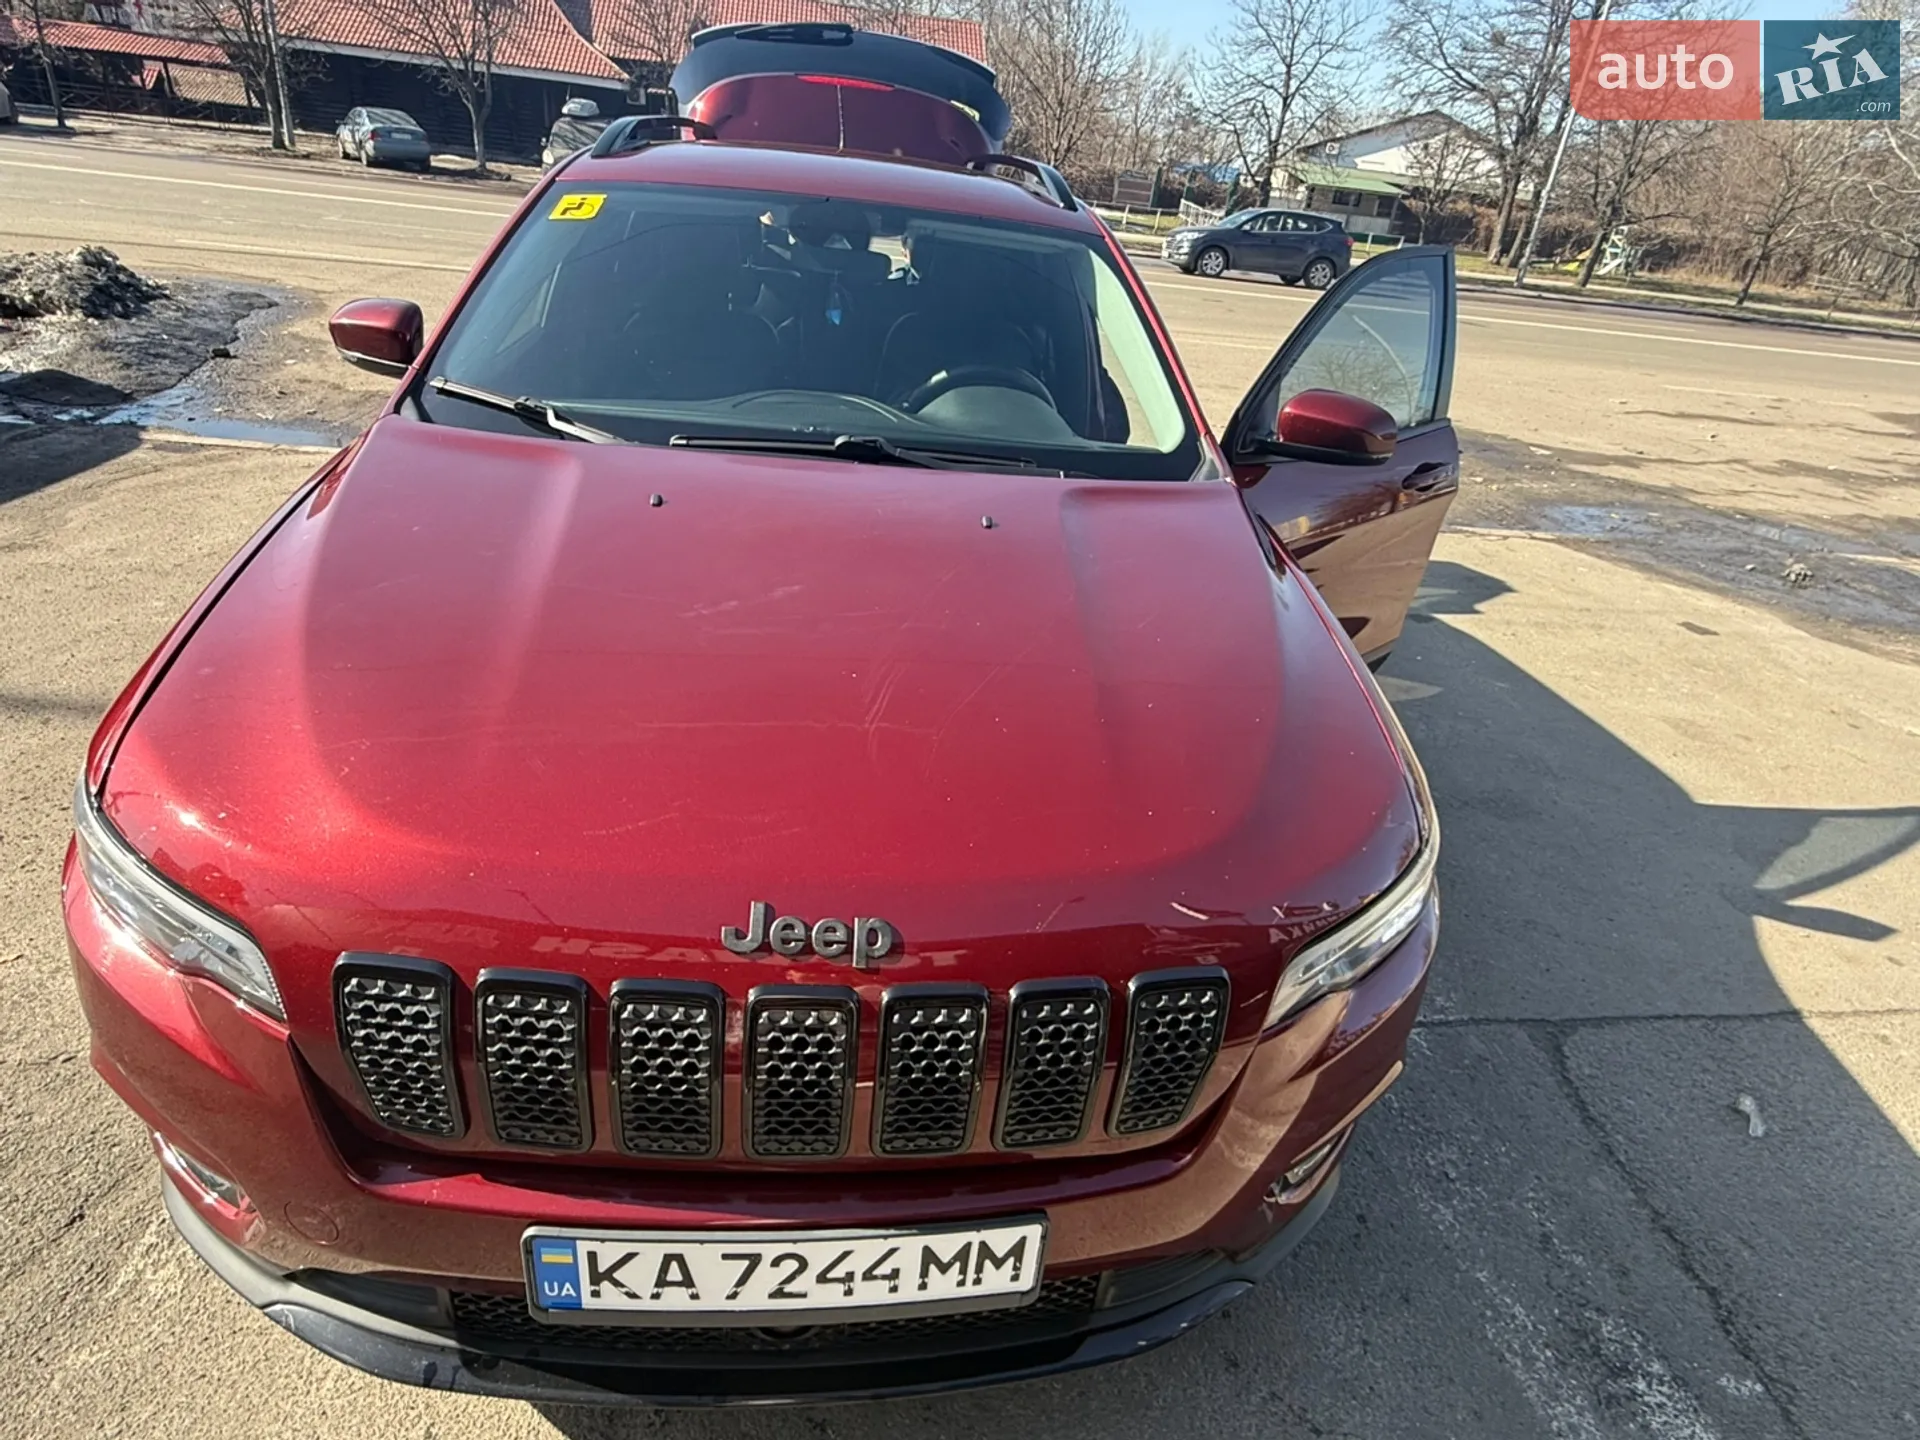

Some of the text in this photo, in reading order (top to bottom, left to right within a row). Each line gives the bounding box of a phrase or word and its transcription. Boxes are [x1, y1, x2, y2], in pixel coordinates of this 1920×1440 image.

[721, 901, 892, 968] Jeep
[543, 1281, 577, 1297] UA
[586, 1235, 1028, 1300] KA 7244 MM
